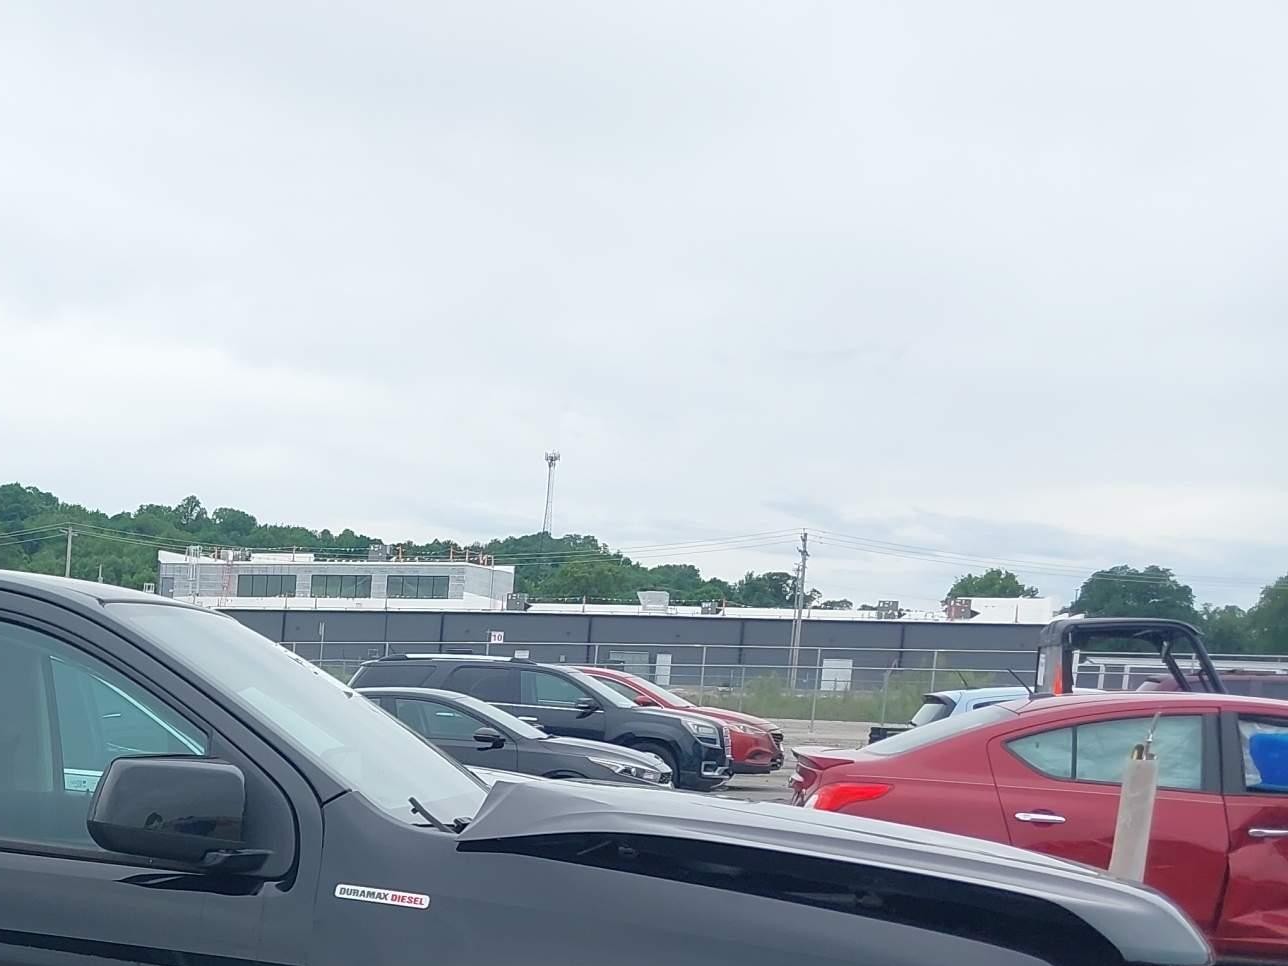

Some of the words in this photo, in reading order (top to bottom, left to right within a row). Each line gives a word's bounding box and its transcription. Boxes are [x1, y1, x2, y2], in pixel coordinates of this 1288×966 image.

[492, 634, 503, 642] 10
[339, 887, 390, 901] DURAMAX
[391, 893, 425, 906] DIESEL
